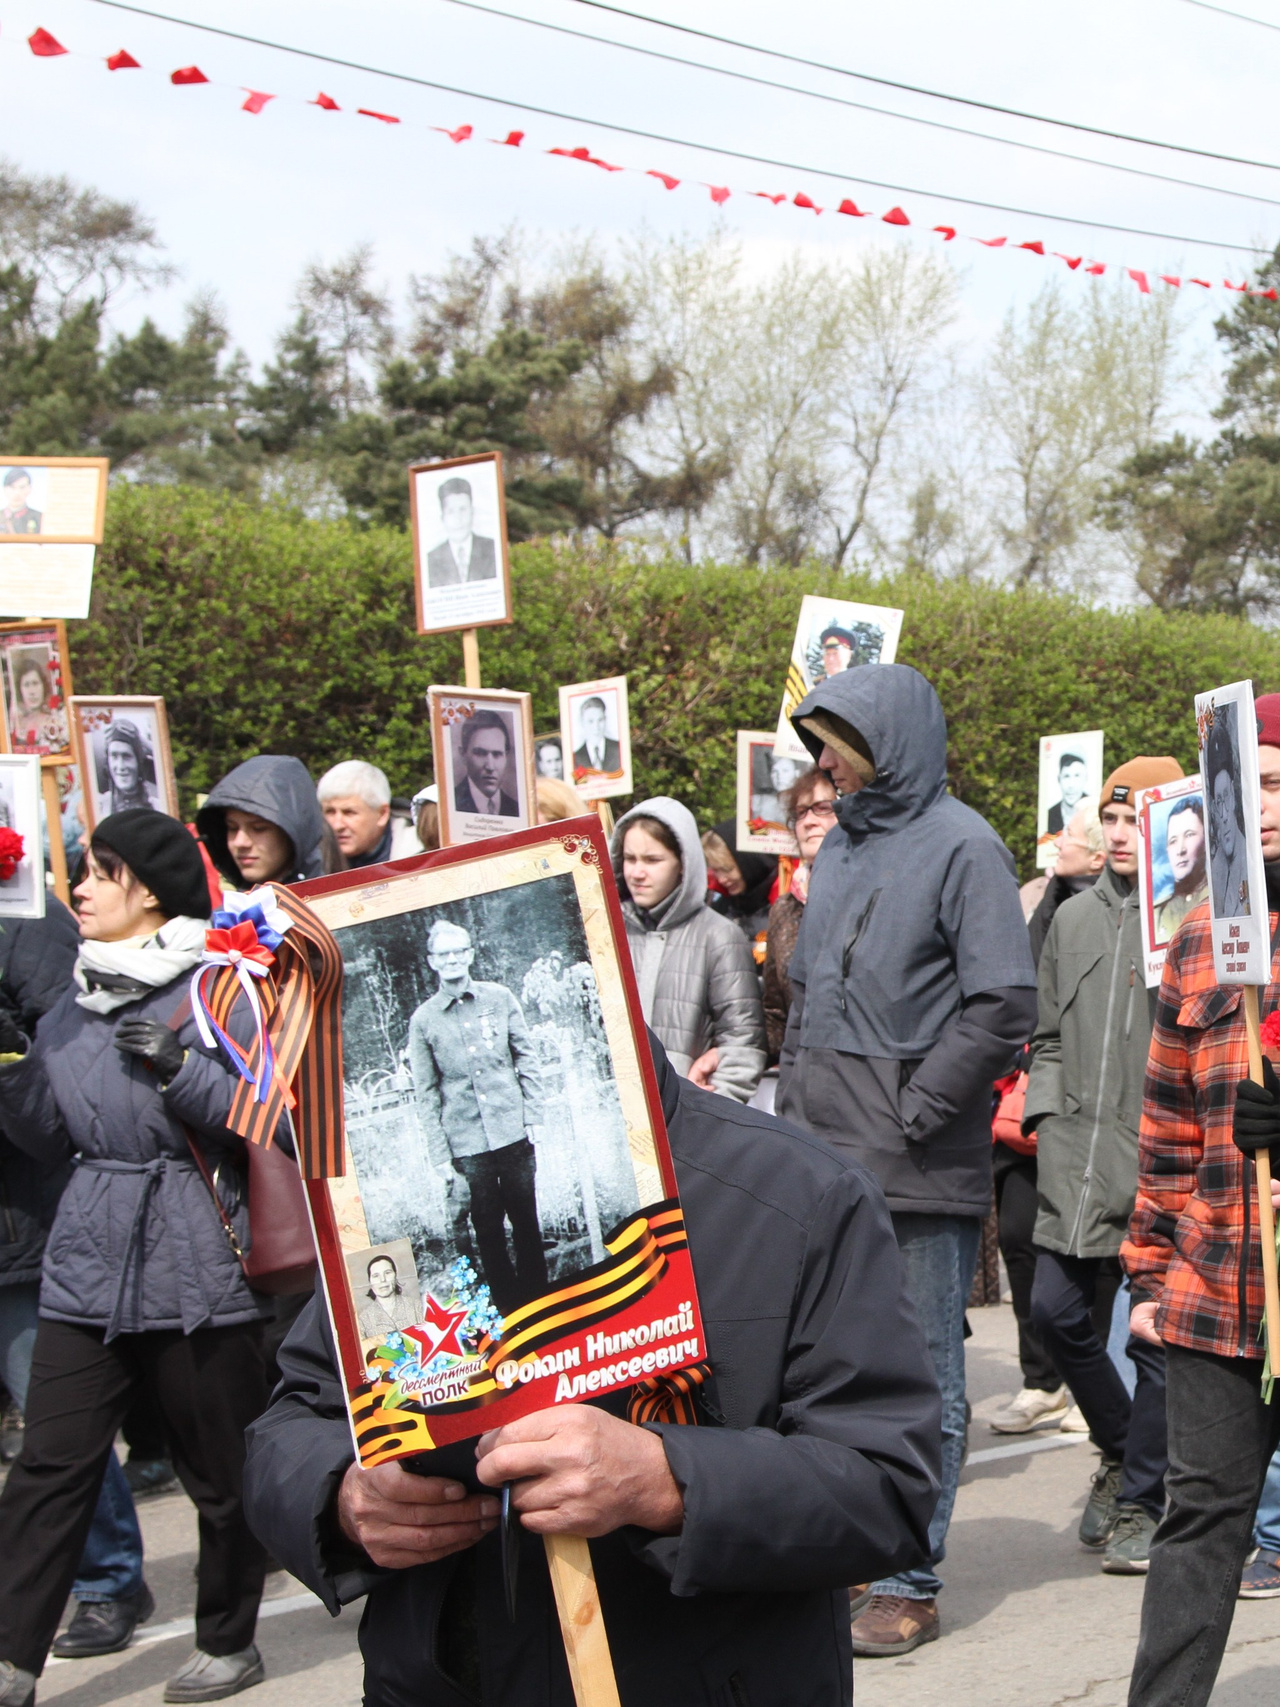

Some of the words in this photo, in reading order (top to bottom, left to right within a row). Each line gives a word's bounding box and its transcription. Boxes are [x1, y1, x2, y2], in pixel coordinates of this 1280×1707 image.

[496, 1351, 581, 1390] Фокин
[585, 1301, 696, 1362] Николай
[554, 1338, 700, 1403] Алексеевич
